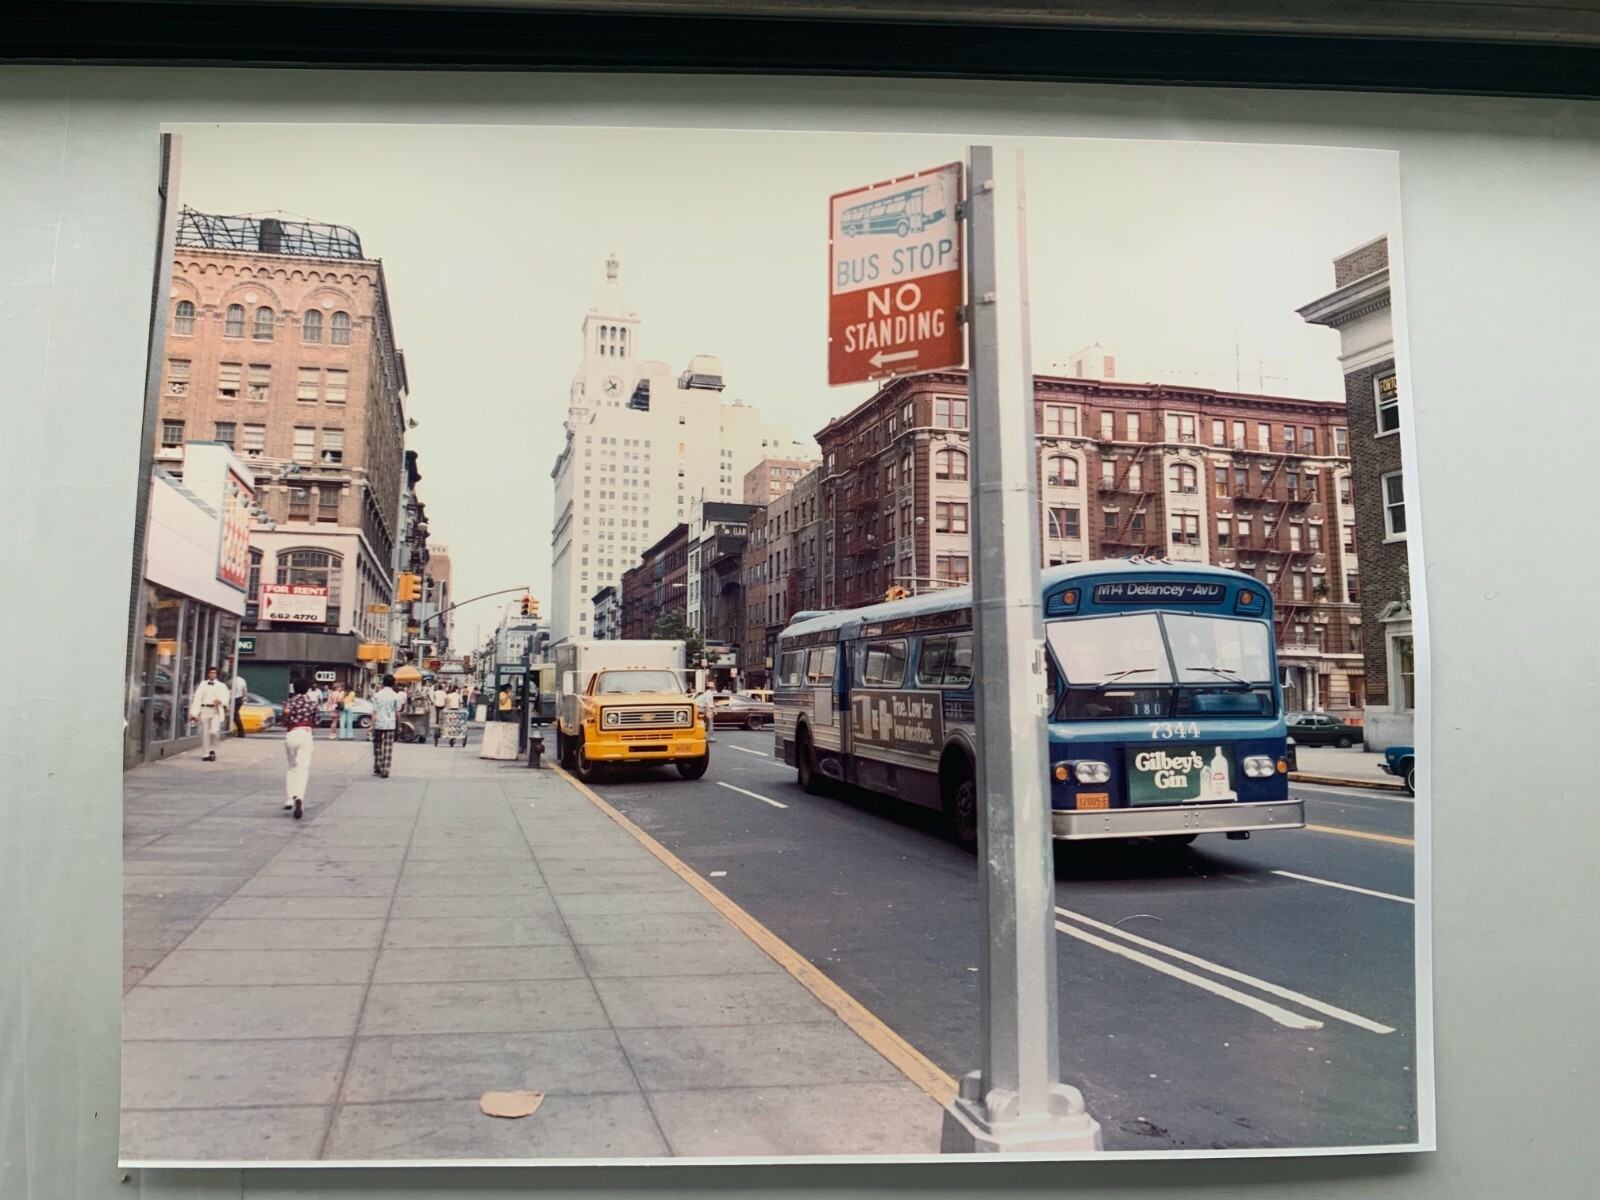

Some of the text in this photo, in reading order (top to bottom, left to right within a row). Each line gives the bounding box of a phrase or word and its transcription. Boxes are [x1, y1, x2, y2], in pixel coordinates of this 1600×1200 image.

[837, 238, 953, 287] BUS STOP
[867, 282, 922, 319] NO
[844, 308, 946, 353] STANDING
[267, 585, 326, 595] FOR RENT
[1098, 584, 1123, 595] M14
[922, 697, 934, 719] tar
[1149, 721, 1200, 739] 7344
[1134, 750, 1204, 774] Gilbey's
[1154, 769, 1189, 789] Gin
